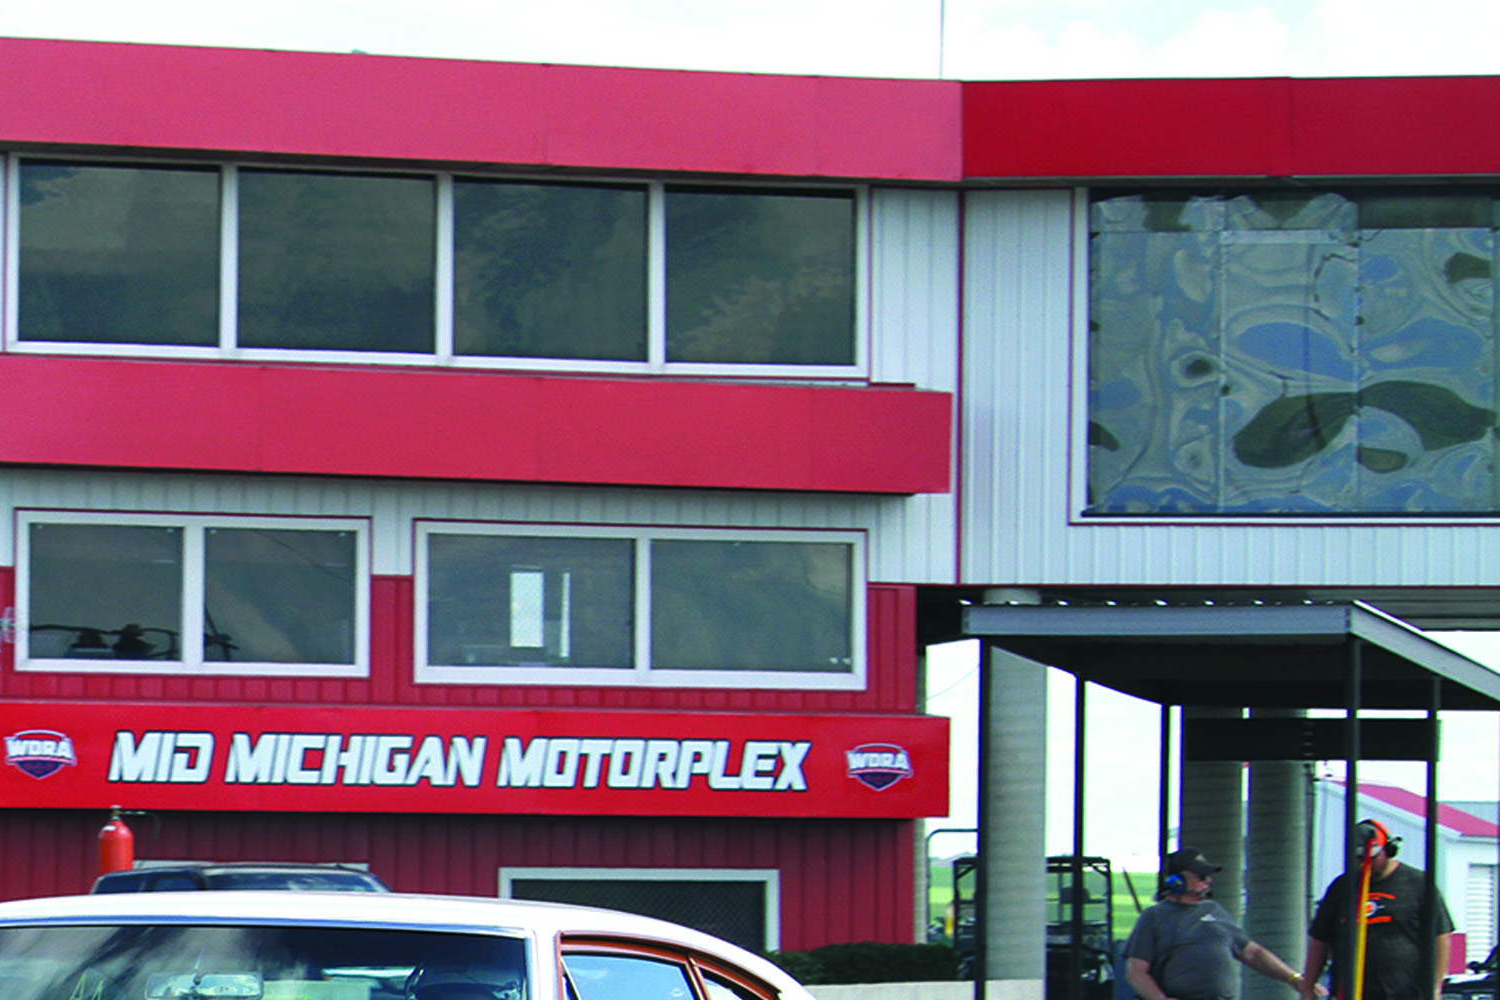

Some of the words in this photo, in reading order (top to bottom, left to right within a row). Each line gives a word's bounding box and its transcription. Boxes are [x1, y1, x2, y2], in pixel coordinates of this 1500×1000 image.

[4, 737, 74, 759] WDRA
[107, 730, 215, 784] MID
[223, 731, 488, 788] MICHIGAN
[496, 736, 812, 792] MOTORPLEX
[844, 750, 910, 771] WDRA
